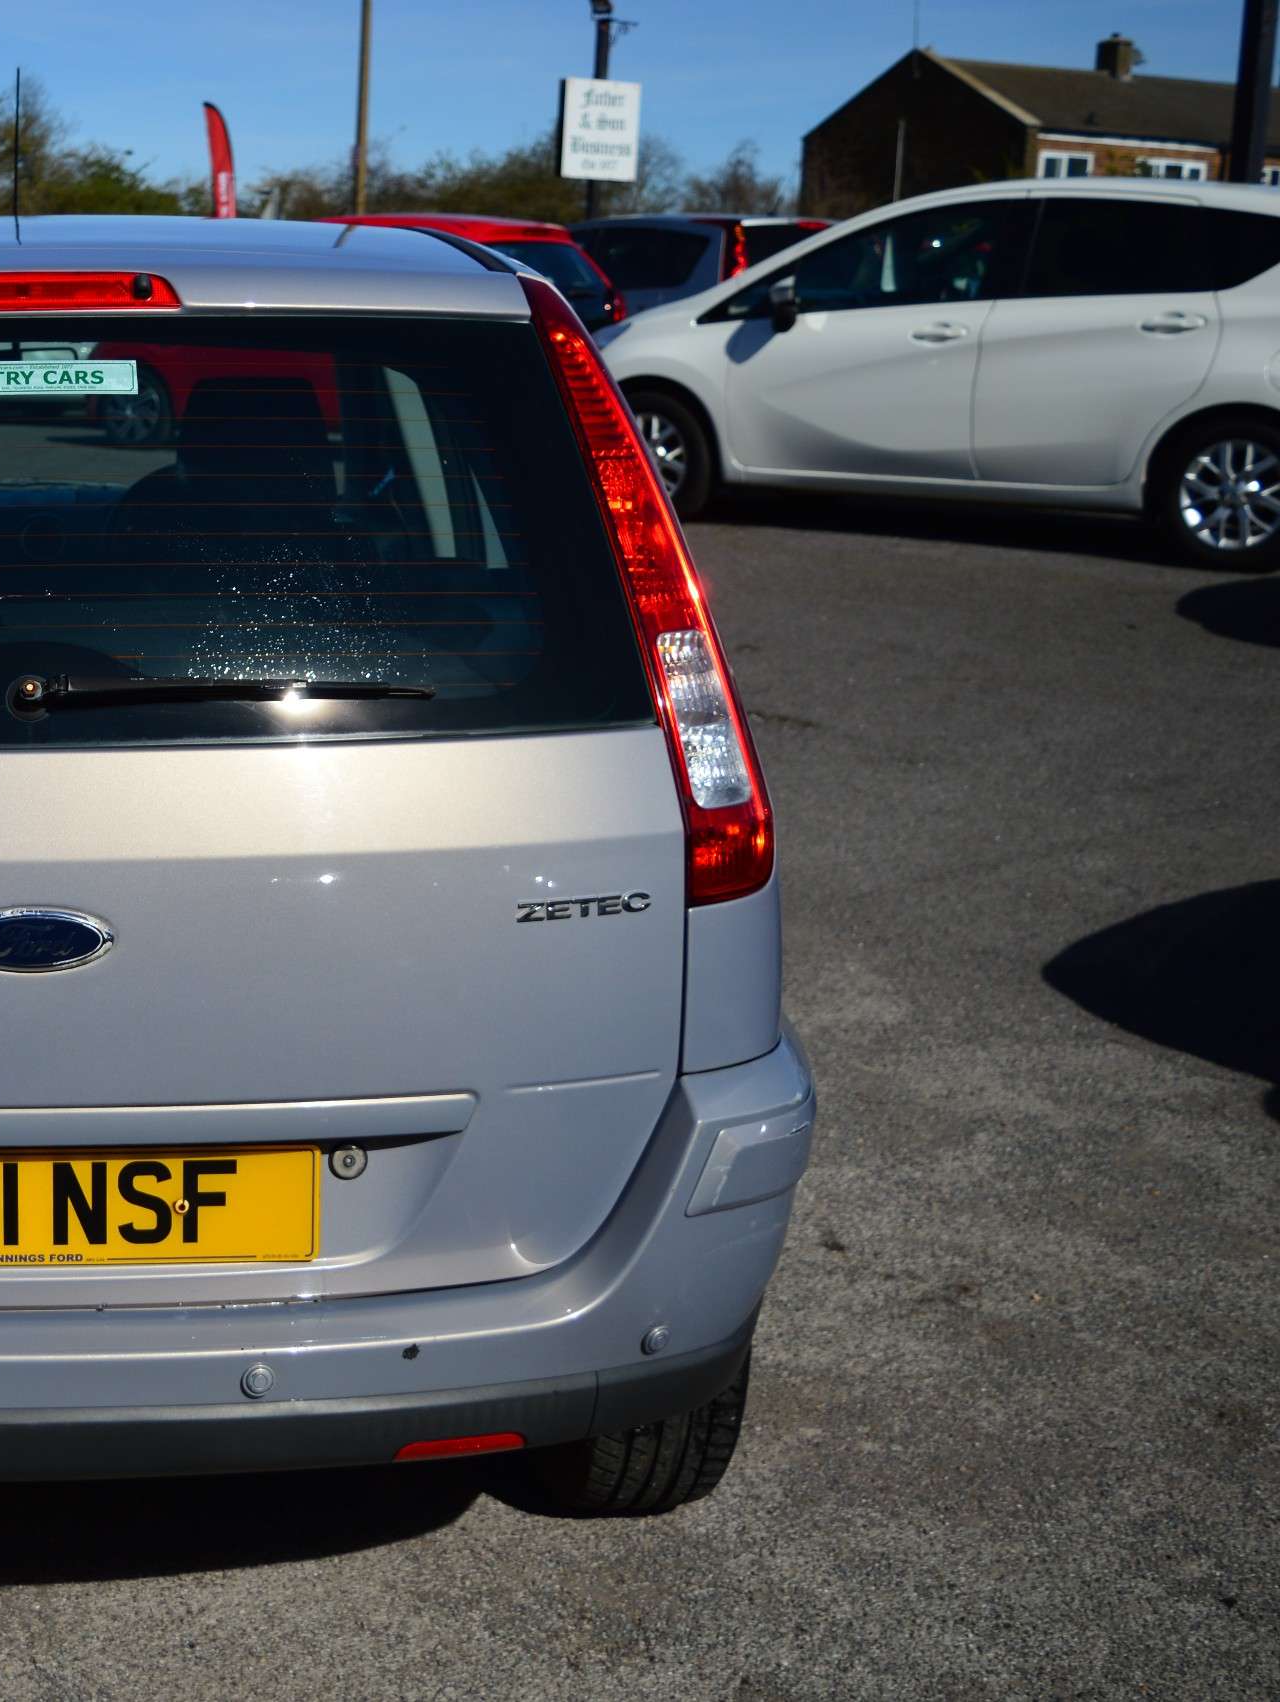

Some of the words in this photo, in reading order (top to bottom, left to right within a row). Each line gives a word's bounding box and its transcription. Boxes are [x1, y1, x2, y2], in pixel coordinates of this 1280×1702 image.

[43, 370, 104, 385] CARS
[516, 891, 652, 923] ZETEC
[52, 1159, 238, 1245] NSF
[50, 1253, 83, 1262] FORD
